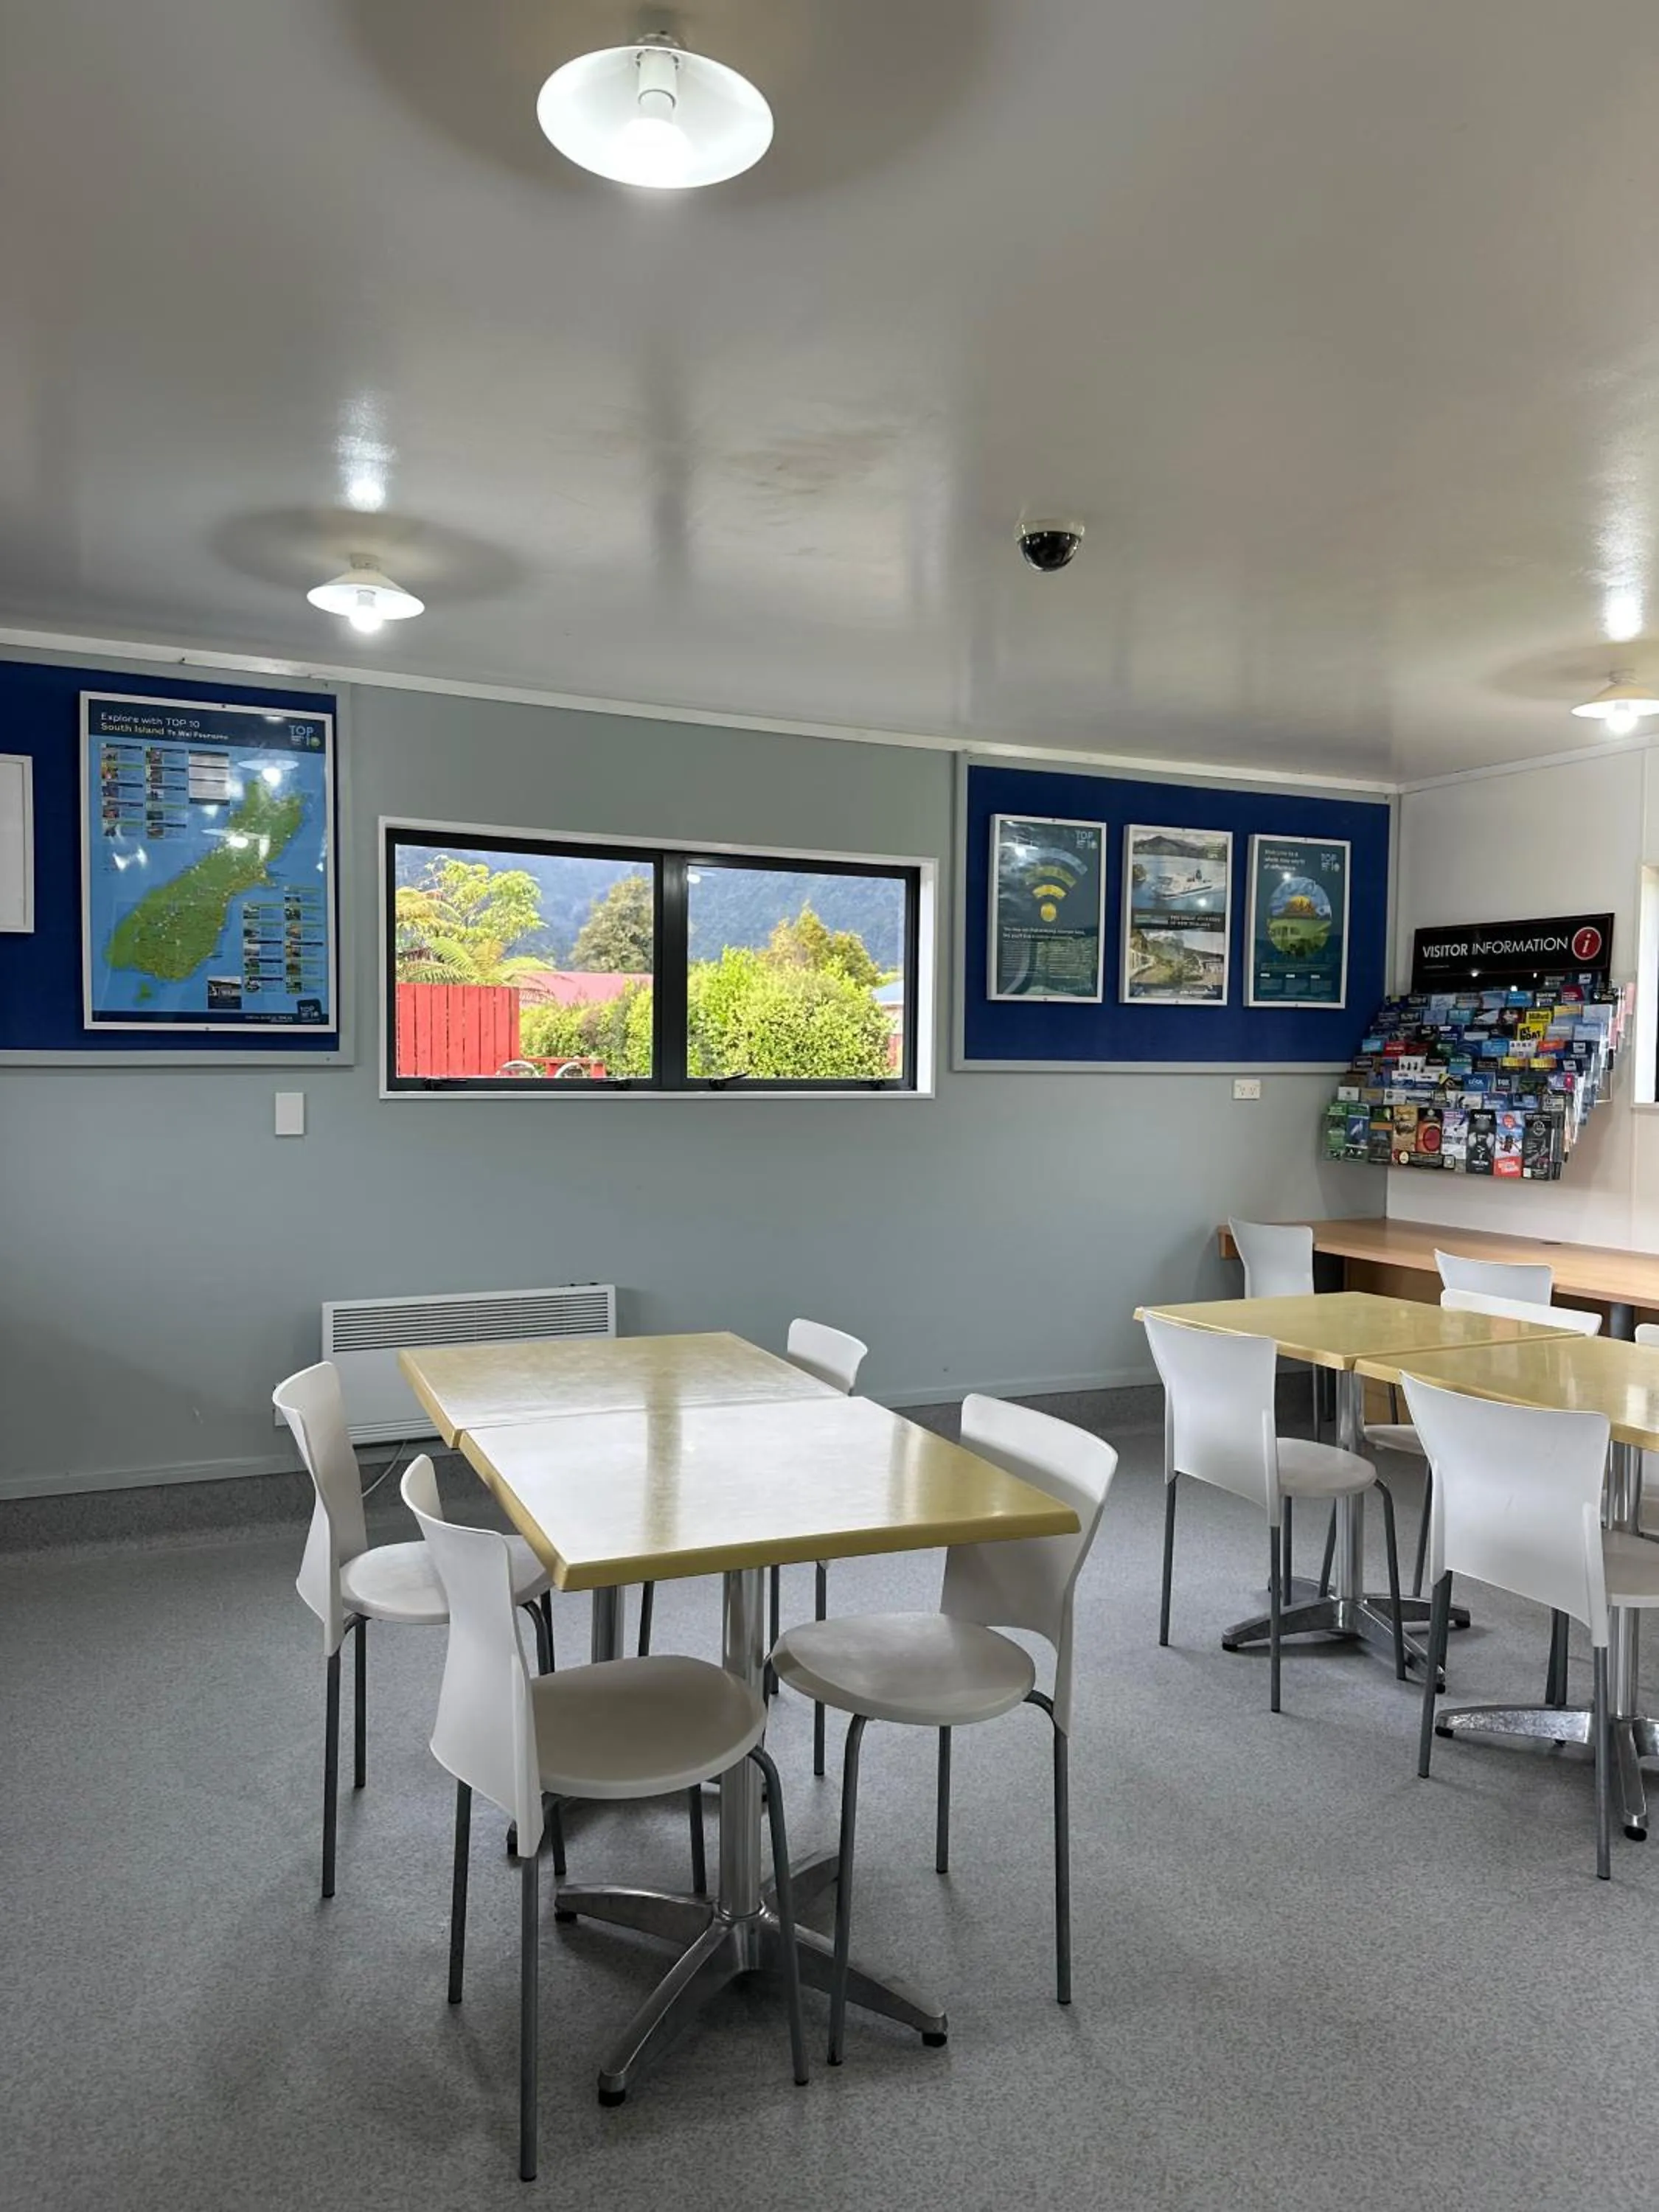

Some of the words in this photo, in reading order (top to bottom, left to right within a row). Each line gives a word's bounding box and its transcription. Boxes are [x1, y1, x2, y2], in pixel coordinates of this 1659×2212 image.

[100, 712, 139, 723] Explore
[141, 717, 162, 725] with
[165, 717, 186, 726] TOP
[189, 720, 200, 728] 10
[100, 723, 132, 732] South
[134, 725, 164, 735] Island
[288, 725, 315, 737] TOP
[1422, 943, 1468, 958] VISITOR
[1472, 936, 1568, 955] INFORMATION
